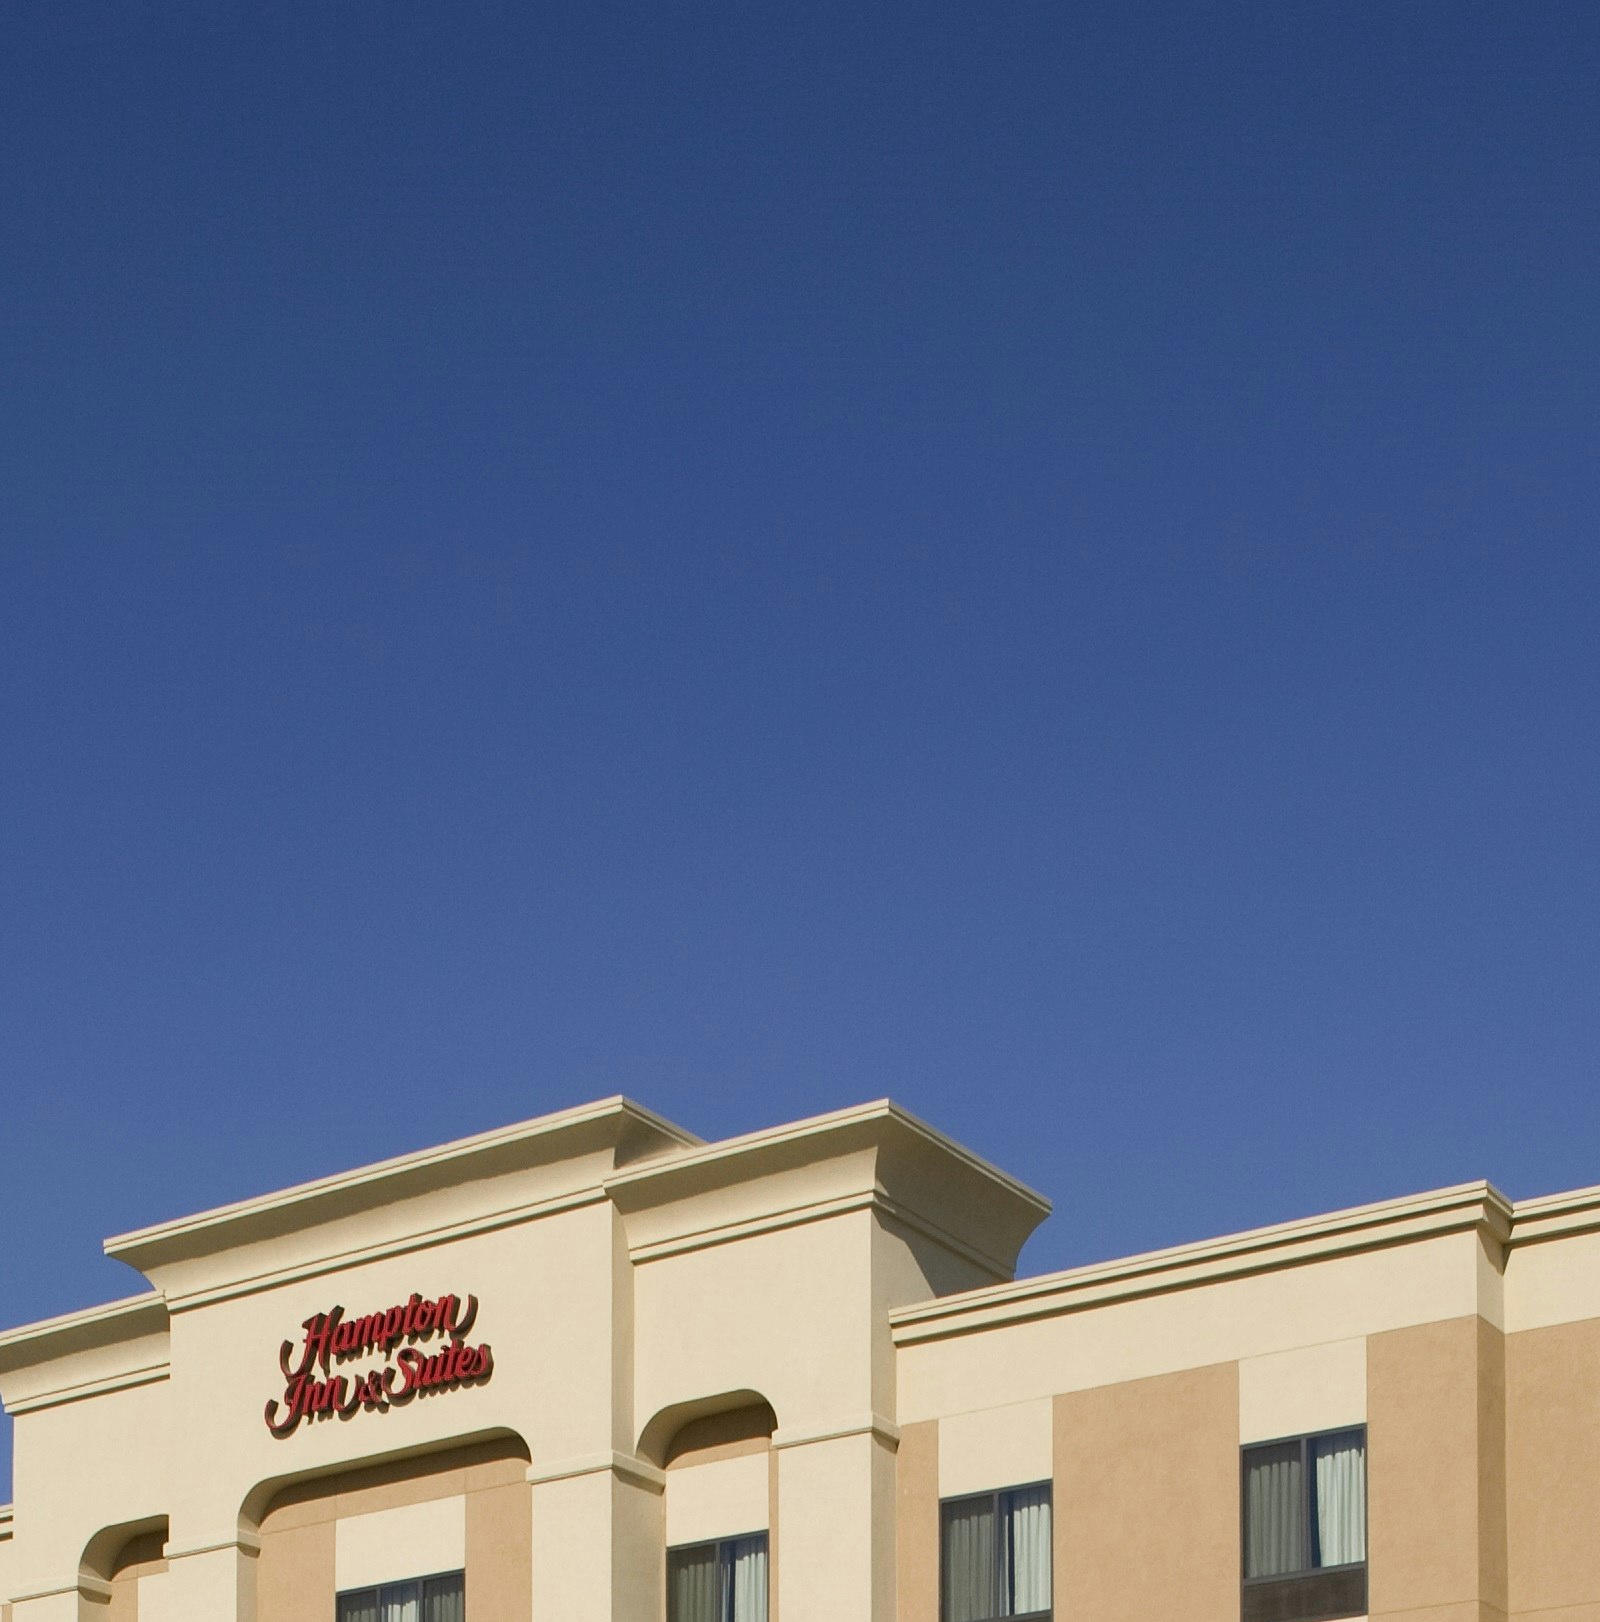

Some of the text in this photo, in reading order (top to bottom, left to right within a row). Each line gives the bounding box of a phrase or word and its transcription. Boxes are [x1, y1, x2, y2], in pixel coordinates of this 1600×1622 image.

[279, 1293, 478, 1379] Hampton
[264, 1374, 365, 1431] Inn
[380, 1338, 493, 1398] Suites
